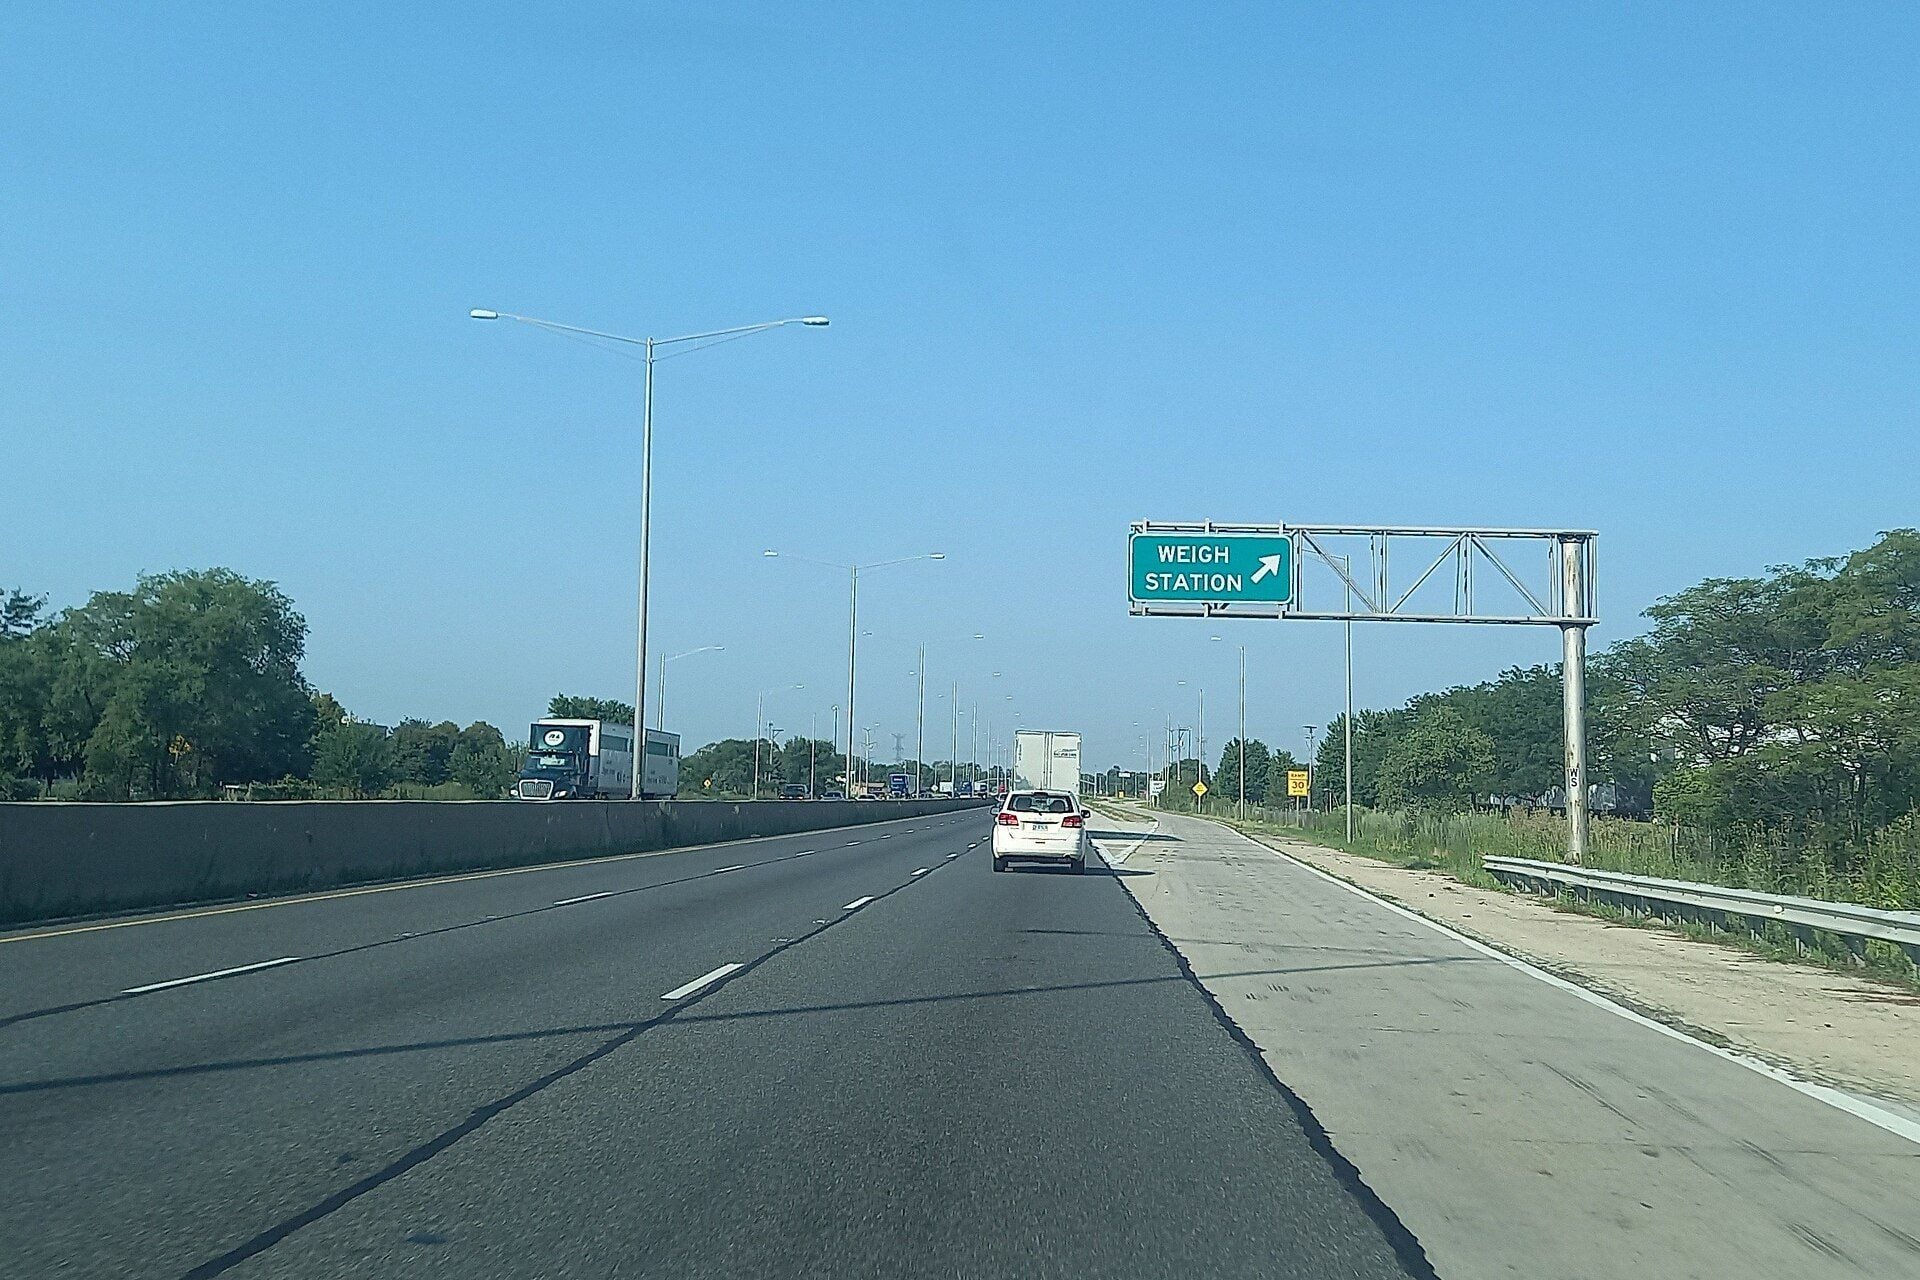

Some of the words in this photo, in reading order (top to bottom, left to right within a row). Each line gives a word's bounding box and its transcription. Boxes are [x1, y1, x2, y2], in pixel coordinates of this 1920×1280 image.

[1157, 545, 1229, 564] WEIGH
[1145, 572, 1242, 592] STATION
[1291, 781, 1305, 789] 30
